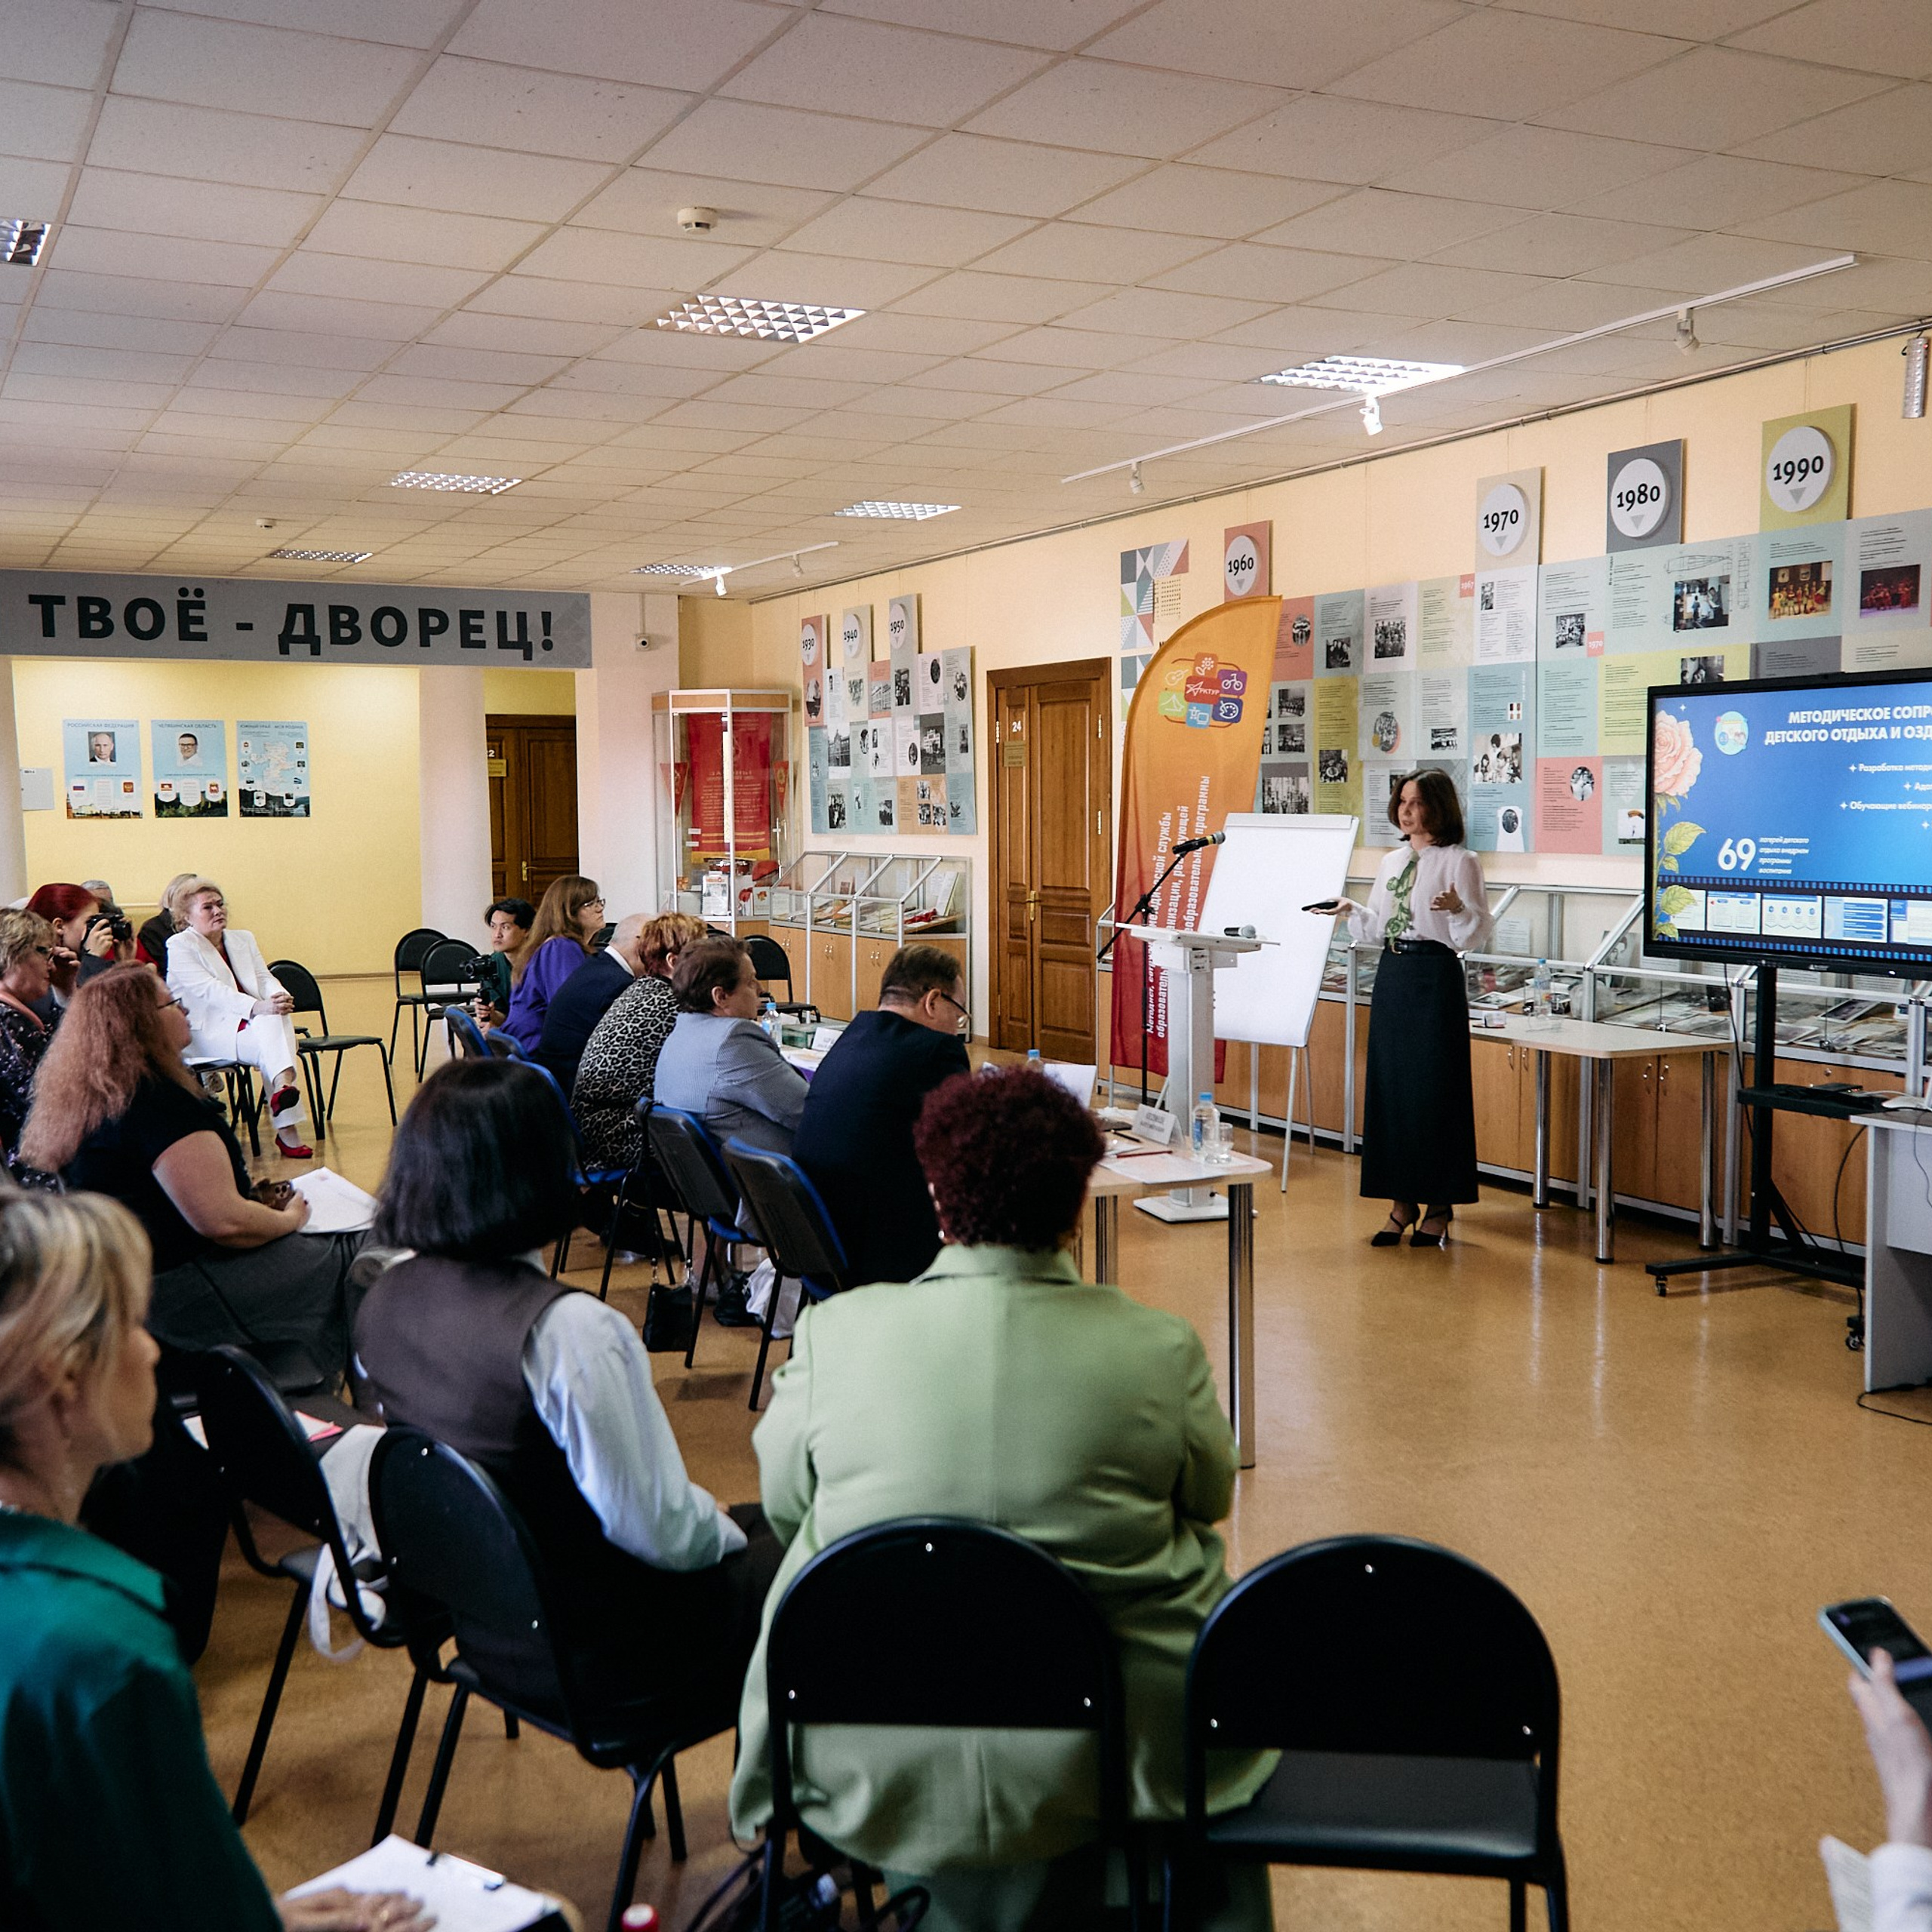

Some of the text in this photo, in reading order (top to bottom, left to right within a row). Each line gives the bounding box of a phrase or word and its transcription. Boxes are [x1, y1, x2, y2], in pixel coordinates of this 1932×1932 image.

[1773, 456, 1824, 485] 1990
[1617, 483, 1660, 512] 1980
[1483, 509, 1518, 533] 1970
[1228, 554, 1254, 576] 1960
[28, 587, 554, 661] ТВОЁ - ДВОРЕЦ!
[844, 629, 858, 641] 1940
[890, 620, 904, 633] 1950
[801, 638, 815, 651] 1930
[1012, 720, 1022, 732] 24
[1788, 705, 1932, 724] МЕТОДИЧЕСКОЕ СОПР
[1764, 728, 1829, 746] ДЕТСКОГО
[1830, 727, 1888, 743] ОТДЫХА
[1890, 726, 1901, 739] И
[1195, 776, 1211, 835] программы
[1718, 838, 1756, 871] 69
[1148, 854, 1166, 928] меодиской
[1158, 812, 1172, 853] службы
[1156, 966, 1169, 1038] образователь
[1173, 805, 1189, 878] реаующей
